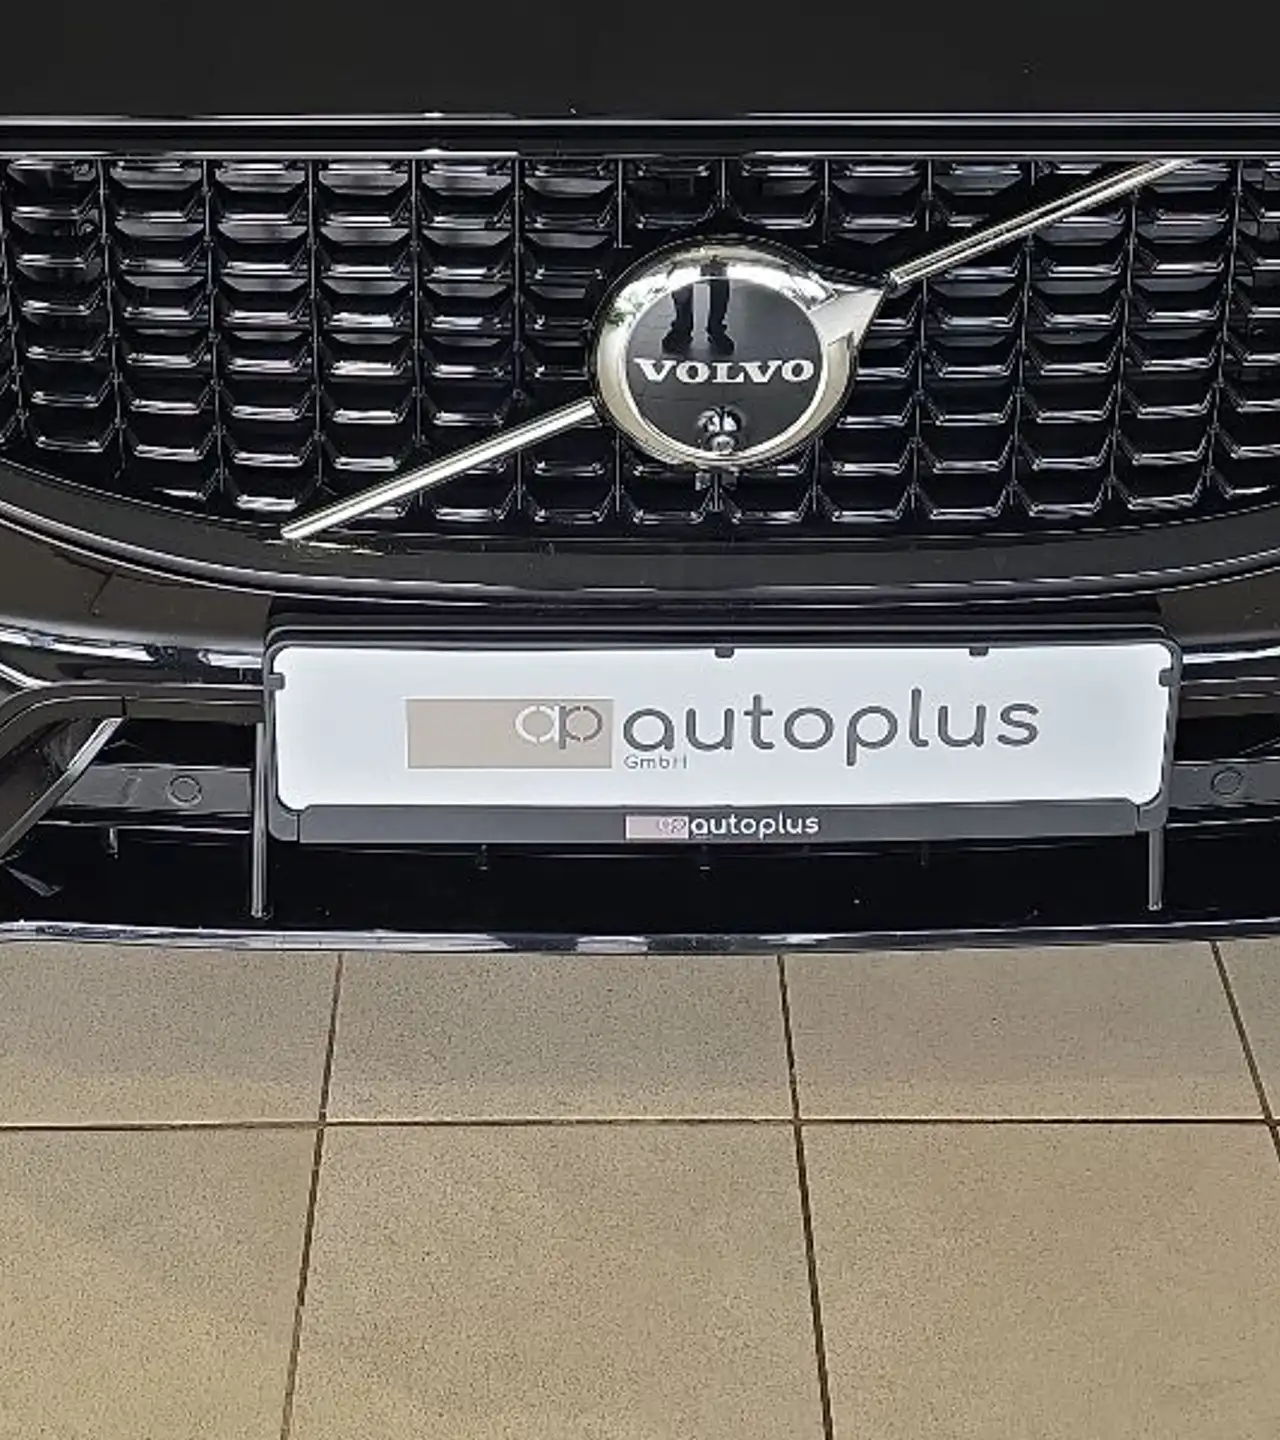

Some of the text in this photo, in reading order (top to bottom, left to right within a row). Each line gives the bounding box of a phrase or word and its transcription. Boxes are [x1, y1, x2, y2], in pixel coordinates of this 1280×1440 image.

[633, 358, 815, 384] VOLVO
[622, 688, 1040, 767] autoplus
[623, 755, 688, 770] GmbH
[690, 811, 820, 840] autoplus
